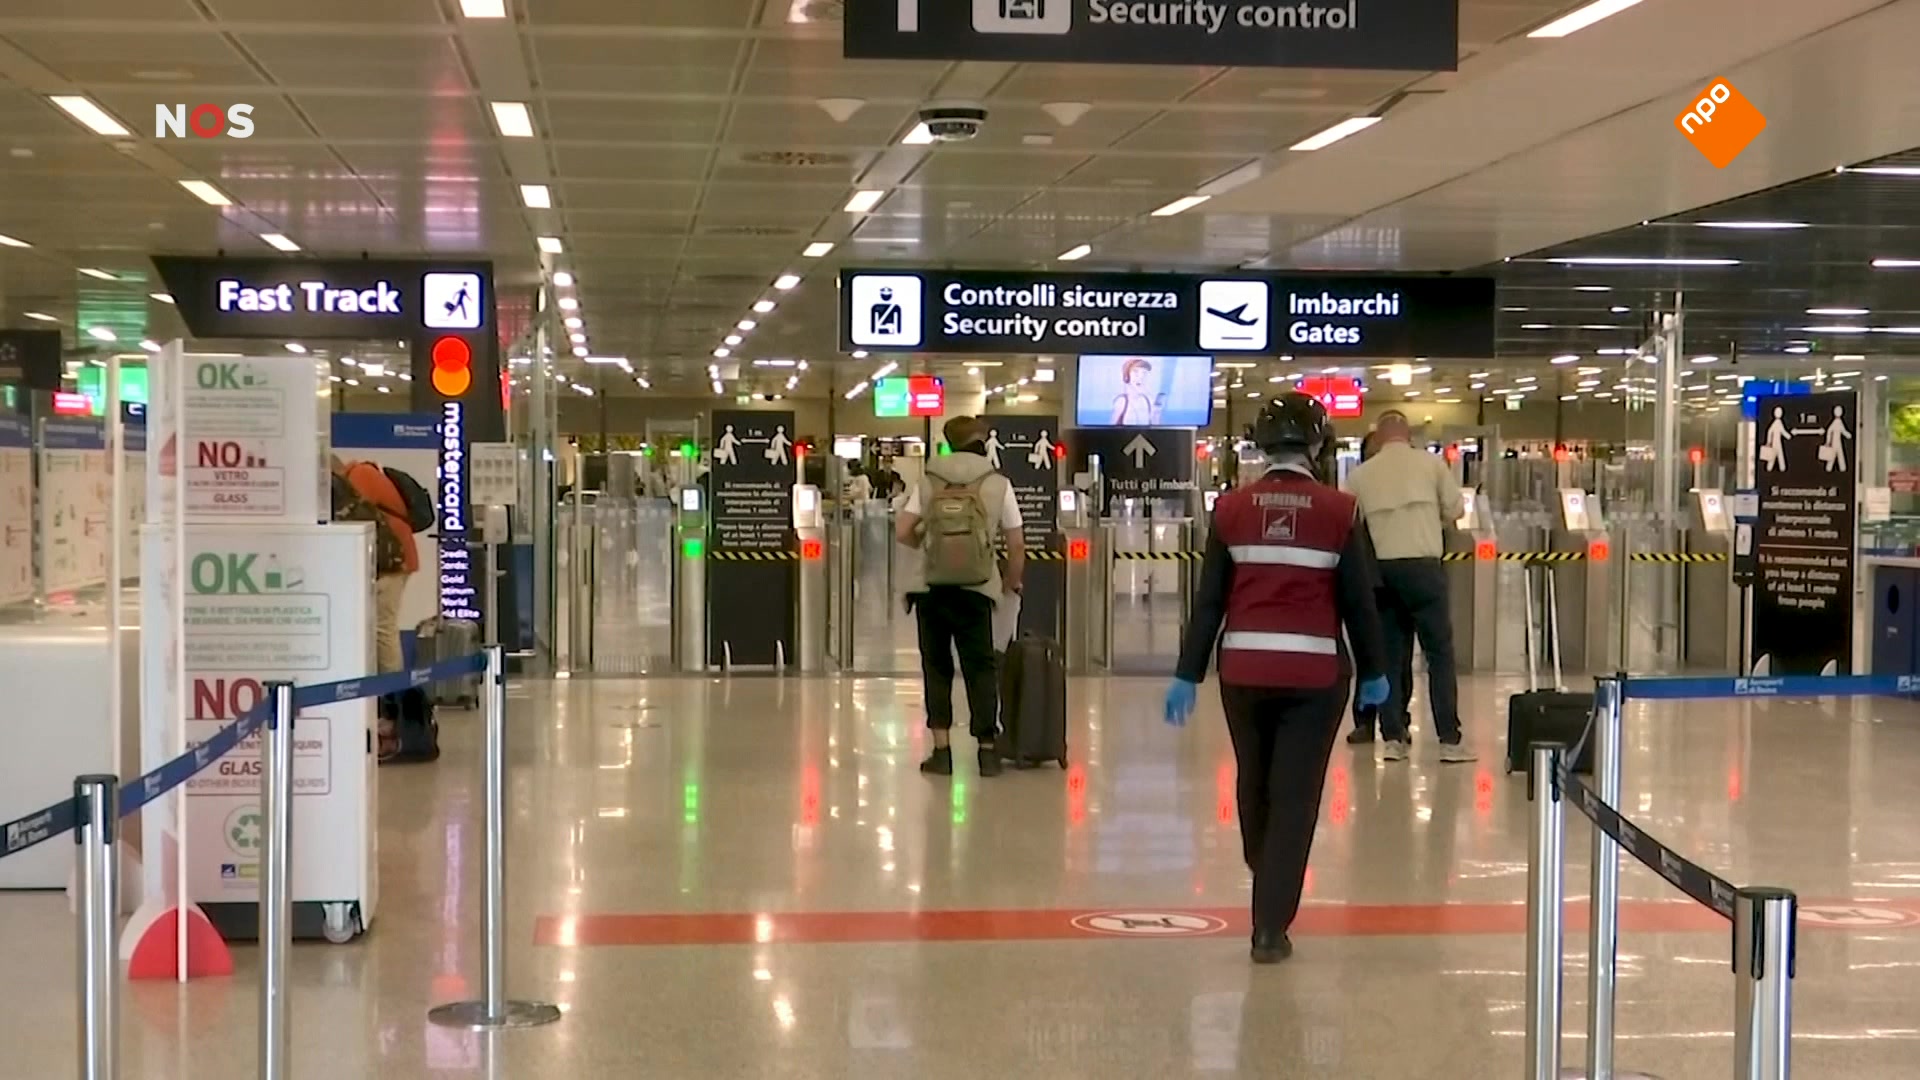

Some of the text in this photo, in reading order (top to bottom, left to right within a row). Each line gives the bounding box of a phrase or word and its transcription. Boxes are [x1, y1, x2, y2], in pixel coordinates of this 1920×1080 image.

[1088, 0, 1357, 34] Security control
[219, 280, 400, 313] Fast Track
[943, 283, 1178, 308] Controlli sicurezza
[1289, 292, 1399, 315] Imbarchi
[943, 313, 1146, 342] Security control
[1289, 321, 1360, 344] Gates
[197, 363, 241, 390] OK
[199, 441, 241, 468] NO
[444, 402, 464, 531] mastercard
[213, 471, 249, 481] VETRO
[1111, 480, 1138, 489] Tutti
[1141, 479, 1157, 493] gli
[213, 494, 249, 503] GLASS
[1252, 494, 1312, 508] TERMINAL
[191, 552, 260, 594] OK
[441, 574, 465, 584] Gold
[194, 677, 263, 720] NO
[219, 761, 262, 776] GLAS
